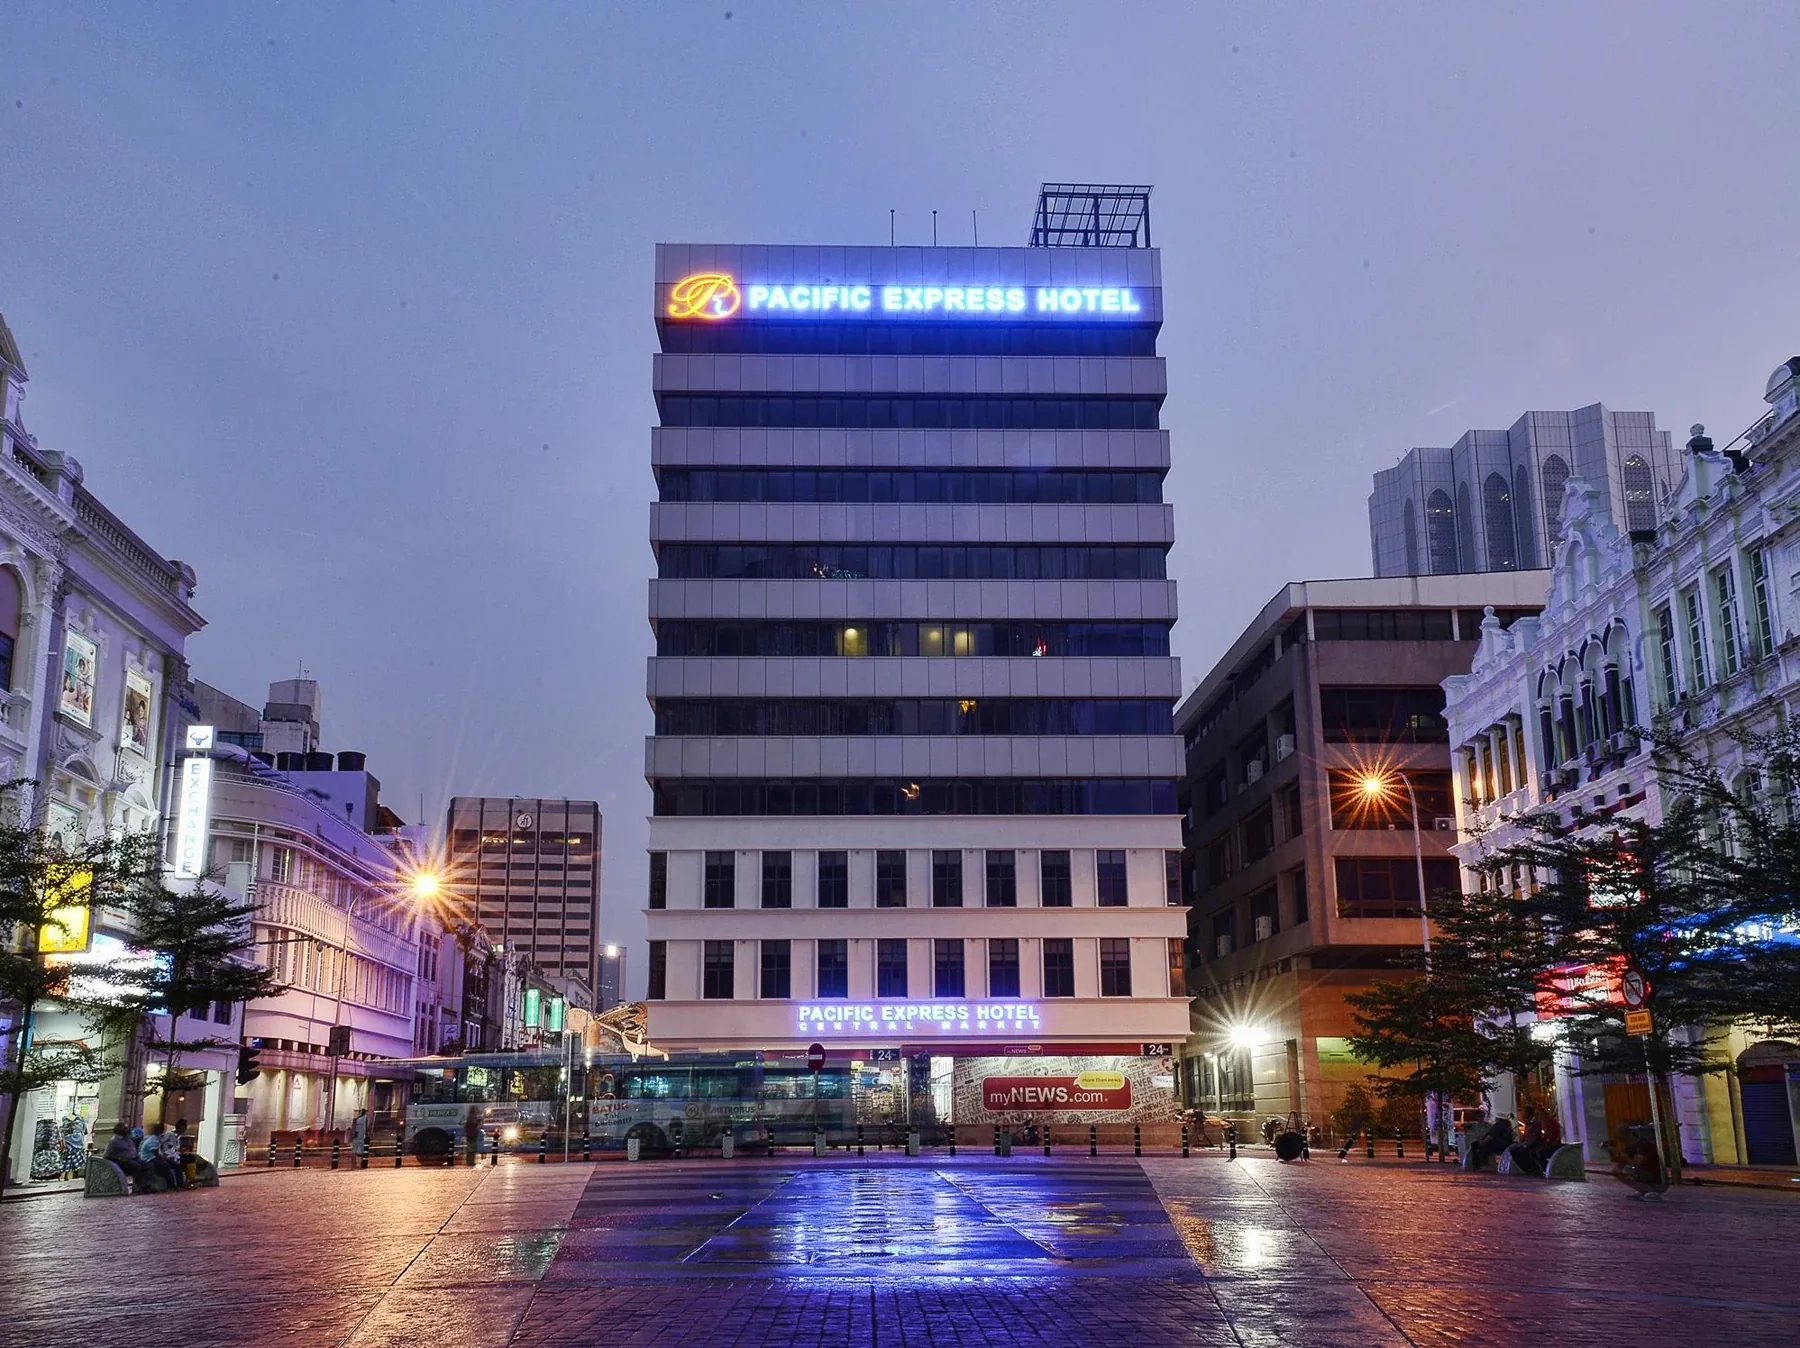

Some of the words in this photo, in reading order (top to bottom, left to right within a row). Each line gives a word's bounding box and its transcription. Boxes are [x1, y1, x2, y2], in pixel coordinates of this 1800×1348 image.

[750, 286, 871, 310] PACIFIC
[883, 287, 1026, 312] EXPRESS
[1037, 288, 1140, 312] HOTEL
[181, 763, 201, 873] EXCHANGE
[799, 1006, 874, 1021] PACIFIC
[881, 1005, 969, 1020] EXPRESS
[976, 1005, 1040, 1020] HOTEL
[799, 1021, 914, 1031] CENTRAL
[941, 1020, 1040, 1030] MARKET
[878, 1050, 892, 1060] 24
[1149, 1044, 1163, 1055] 24
